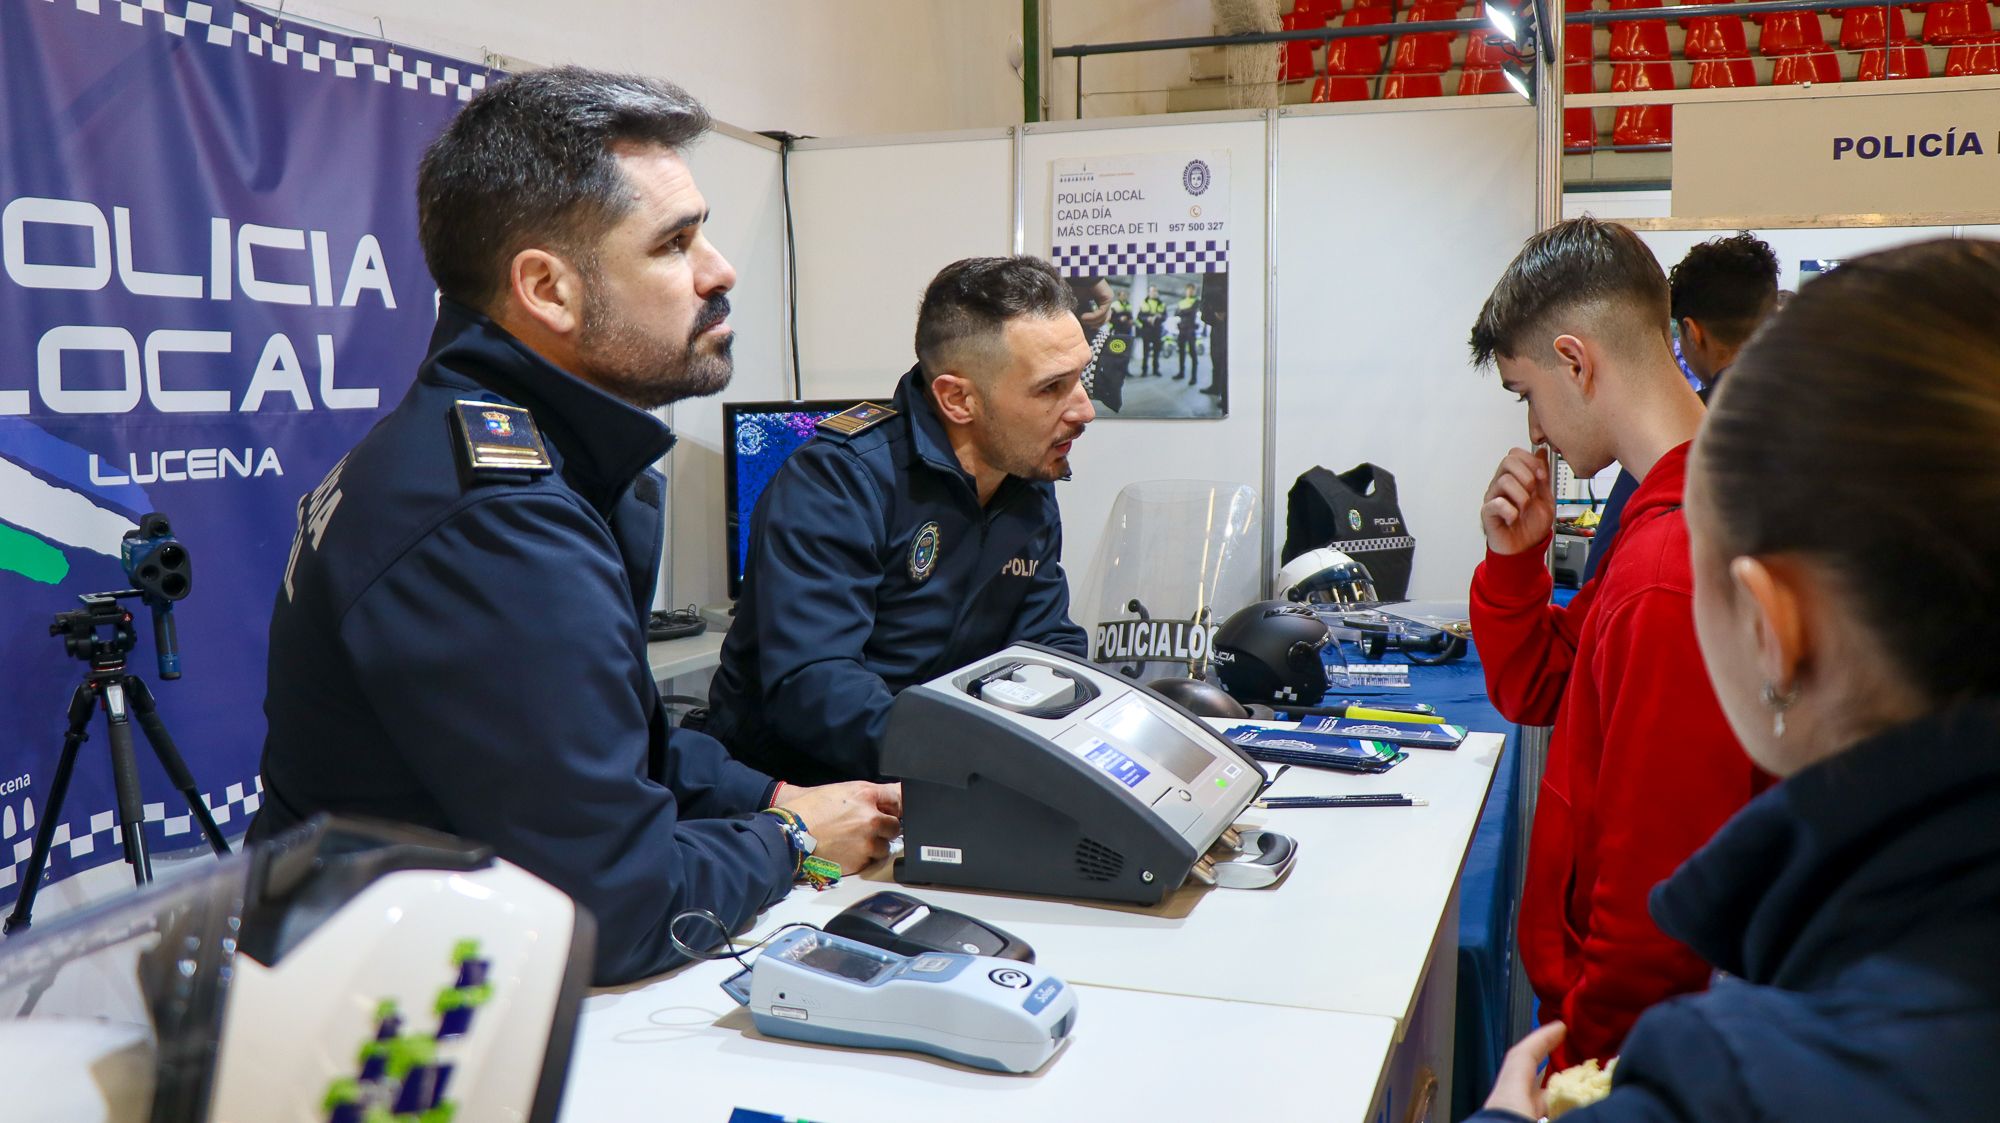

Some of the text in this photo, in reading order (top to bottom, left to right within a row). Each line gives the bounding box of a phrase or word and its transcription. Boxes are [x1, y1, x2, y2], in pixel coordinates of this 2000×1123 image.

[1833, 127, 1984, 160] POLICÍA
[1057, 188, 1145, 204] POLICÍA LOCAL
[1057, 205, 1112, 221] CADA DÍA
[1057, 222, 1158, 237] MÁS CERCA DE TI
[1169, 221, 1224, 232] 957 500 327
[2, 197, 397, 309] OLICIA
[89, 447, 284, 486] LUCENA
[1374, 517, 1400, 525] POLICIA
[1096, 622, 1172, 658] POLICIA
[0, 773, 31, 796] cena
